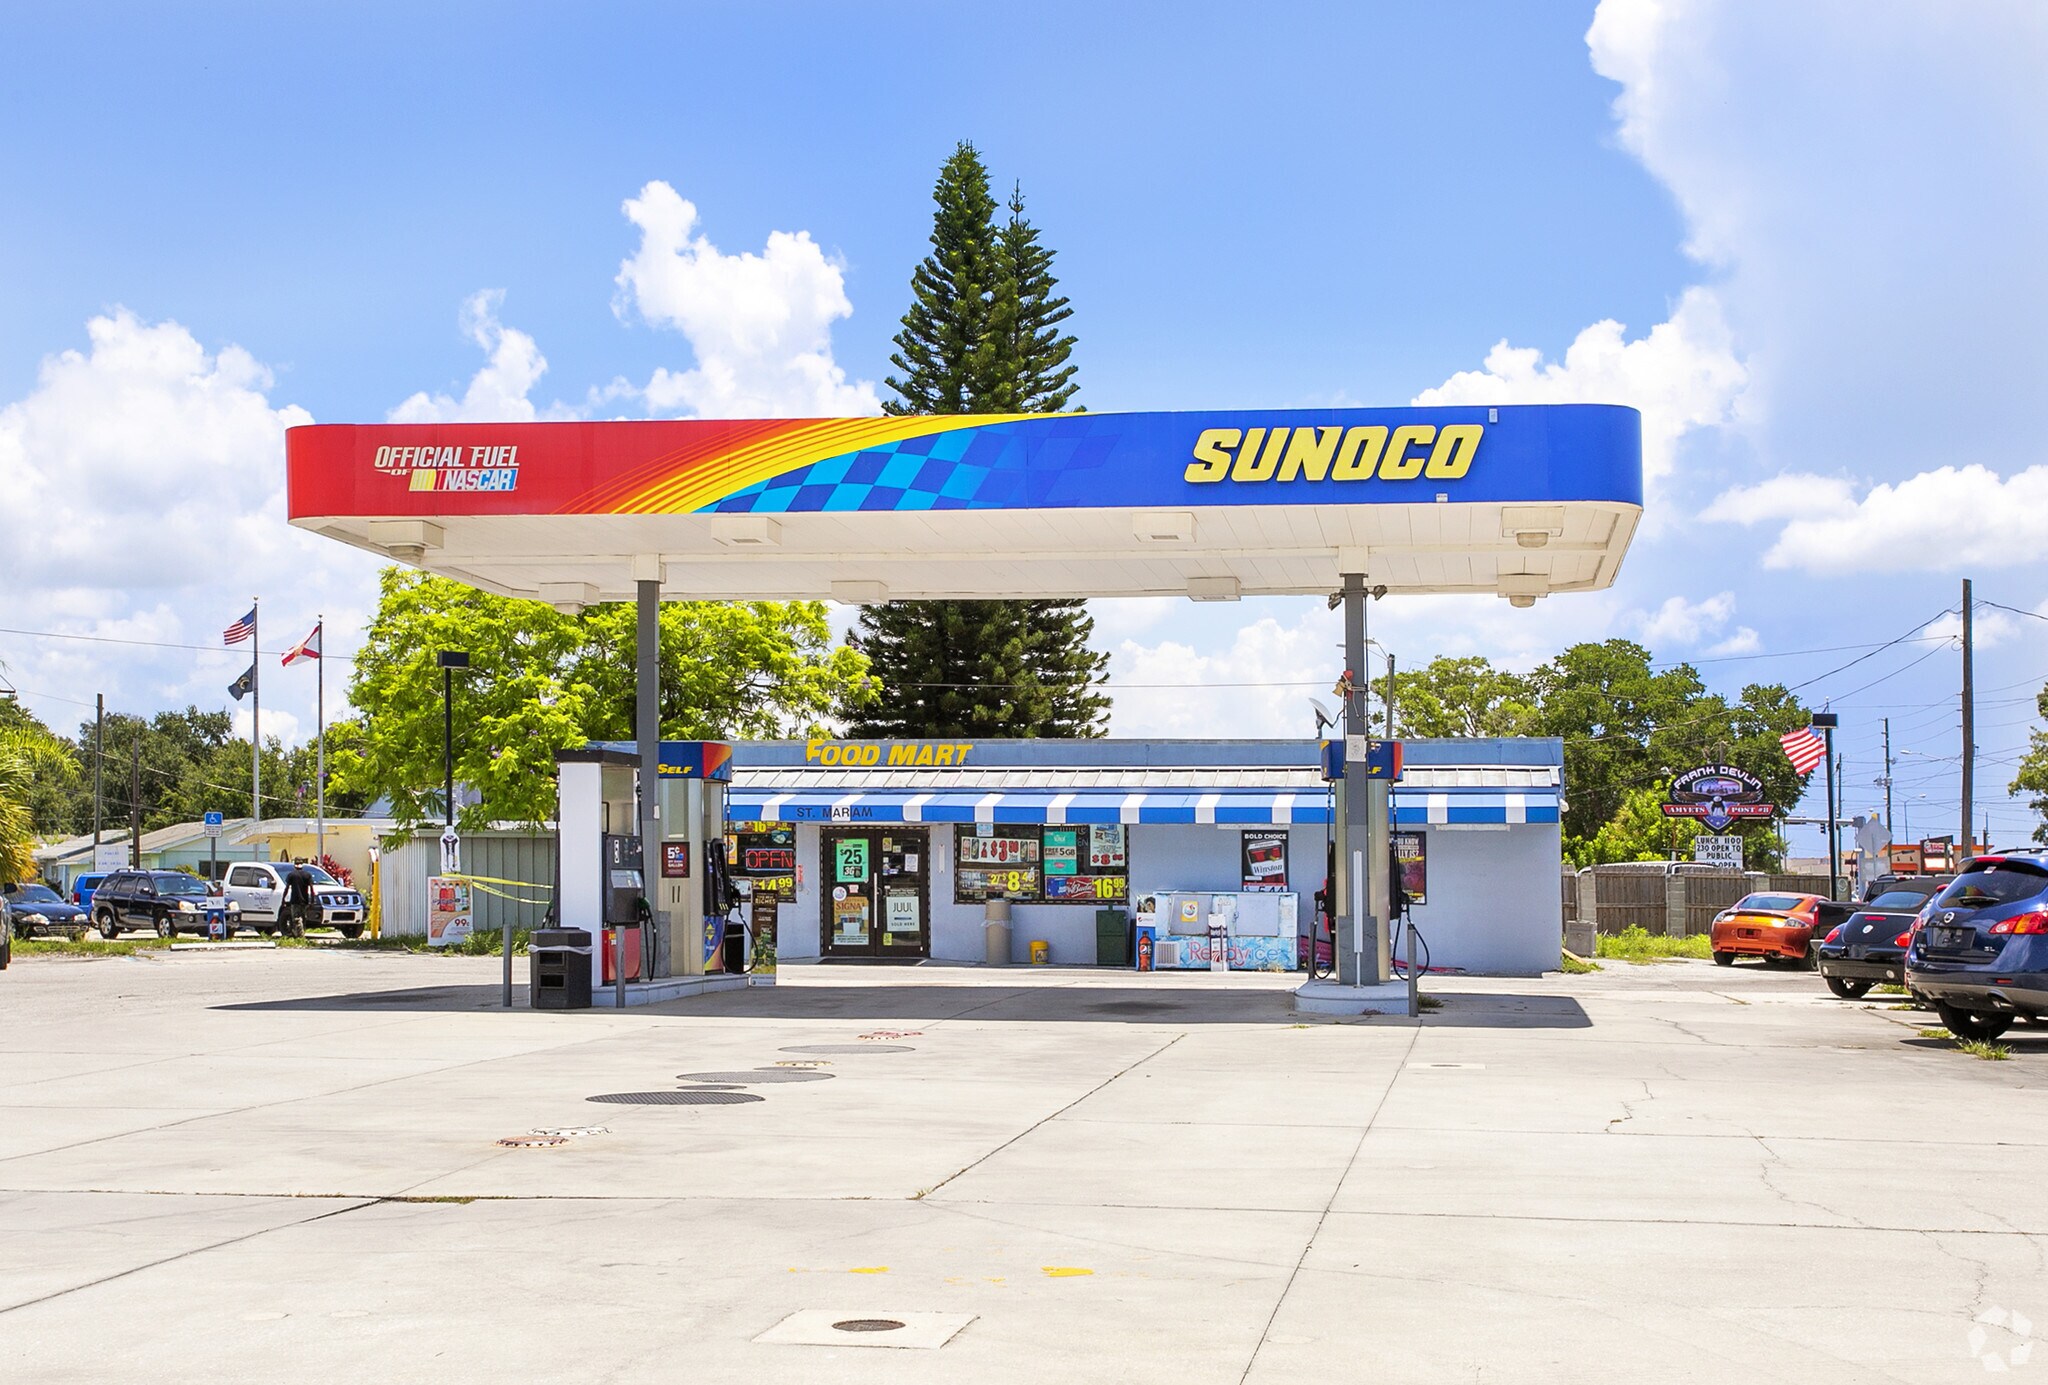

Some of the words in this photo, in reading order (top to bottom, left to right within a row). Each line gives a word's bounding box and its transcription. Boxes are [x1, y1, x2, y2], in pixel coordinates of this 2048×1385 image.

[374, 445, 465, 468] OFFICIAL
[468, 445, 520, 467] FUEL
[1184, 424, 1484, 484] SUNOCO
[445, 469, 515, 491] NASCAR
[805, 739, 881, 766] FOOD
[887, 744, 973, 766] MART
[657, 763, 693, 774] SELF
[1673, 766, 1715, 789] FRANK
[1720, 766, 1762, 790] DEVLIN
[796, 807, 816, 818] ST.
[822, 806, 873, 818] MARIAM
[1697, 844, 1709, 852] 230
[1711, 844, 1730, 852] OPEN
[1732, 844, 1742, 852] TO
[1706, 852, 1733, 860] PUBLIC
[840, 849, 863, 865] $25
[1253, 864, 1283, 875] Winston
[892, 902, 913, 913] JUUL
[1189, 941, 1250, 967] Redy
